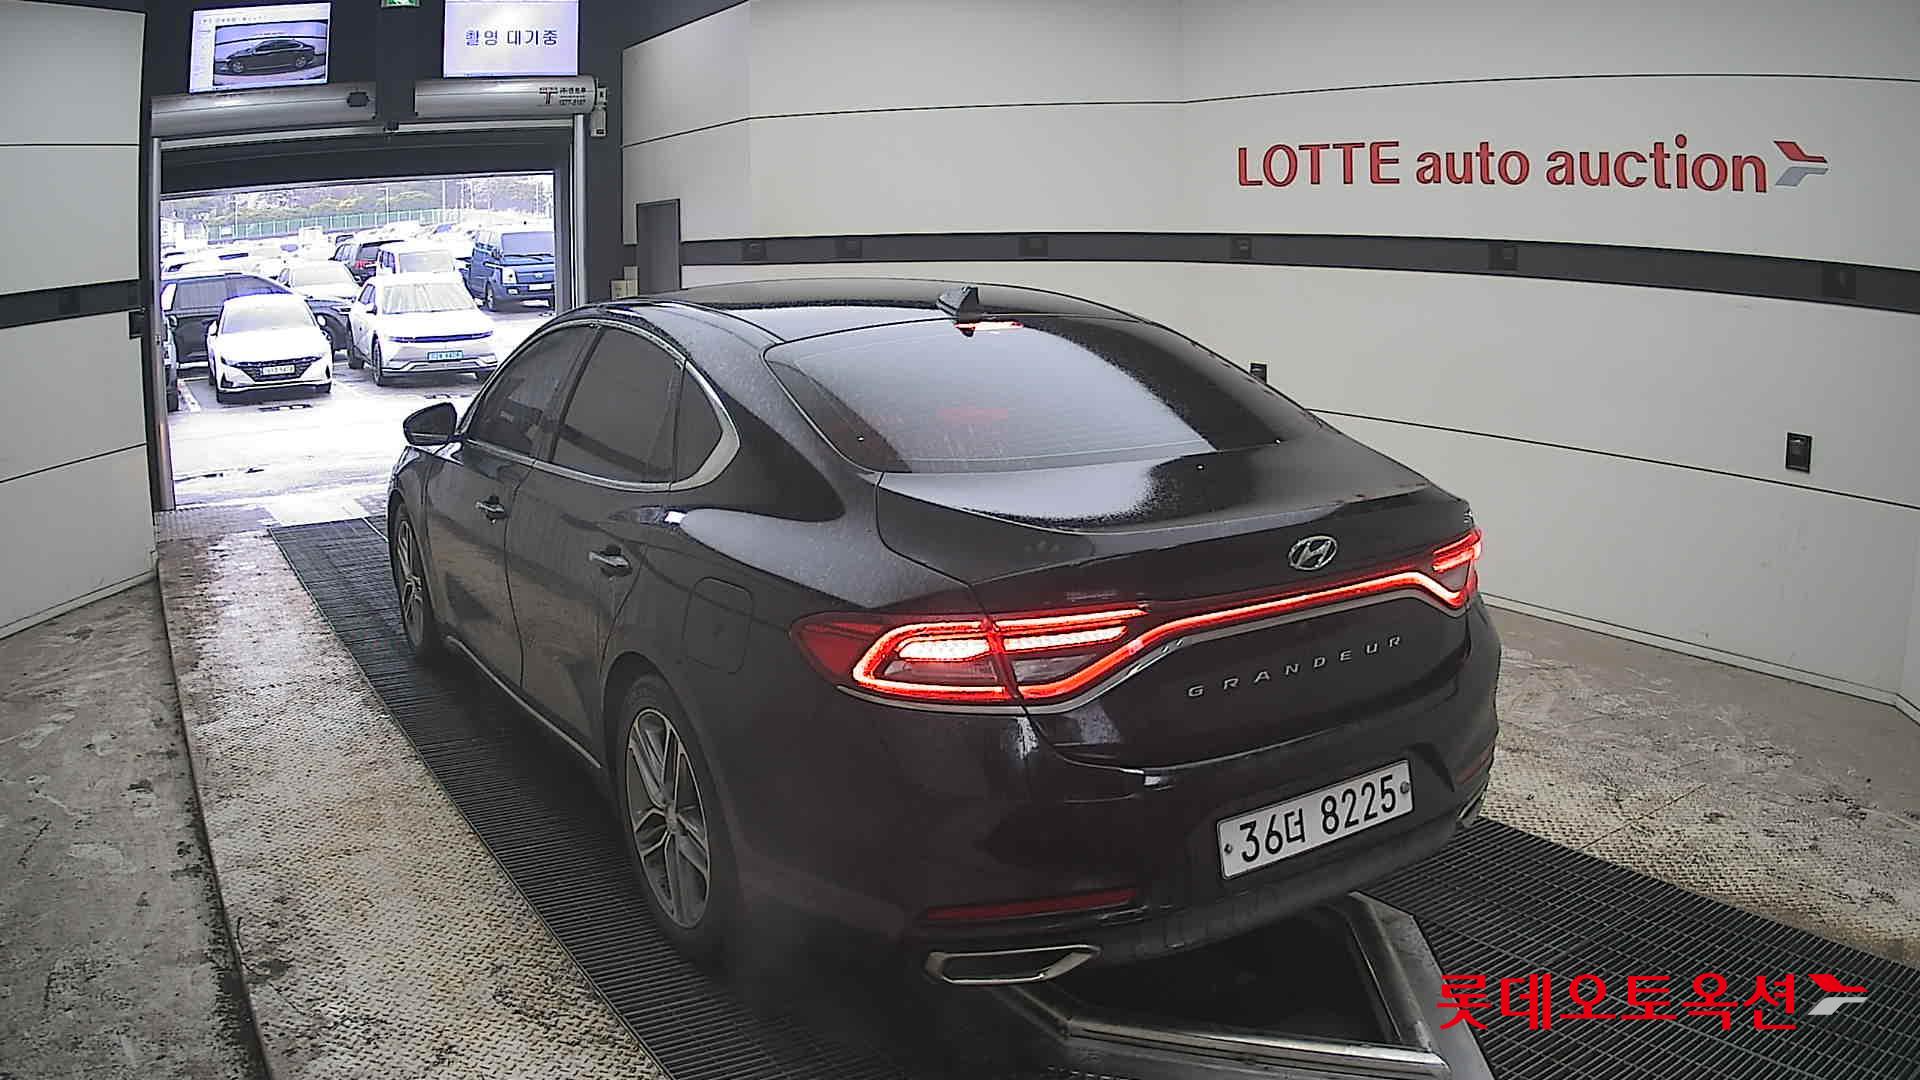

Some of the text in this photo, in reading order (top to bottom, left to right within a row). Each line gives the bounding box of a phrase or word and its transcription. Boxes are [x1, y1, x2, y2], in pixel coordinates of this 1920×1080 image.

[507, 30, 558, 46] 대기중
[1238, 134, 1768, 192] LOTTE auto auction
[1187, 636, 1402, 697] GRANDEUR
[1239, 774, 1397, 863] 36더 8225
